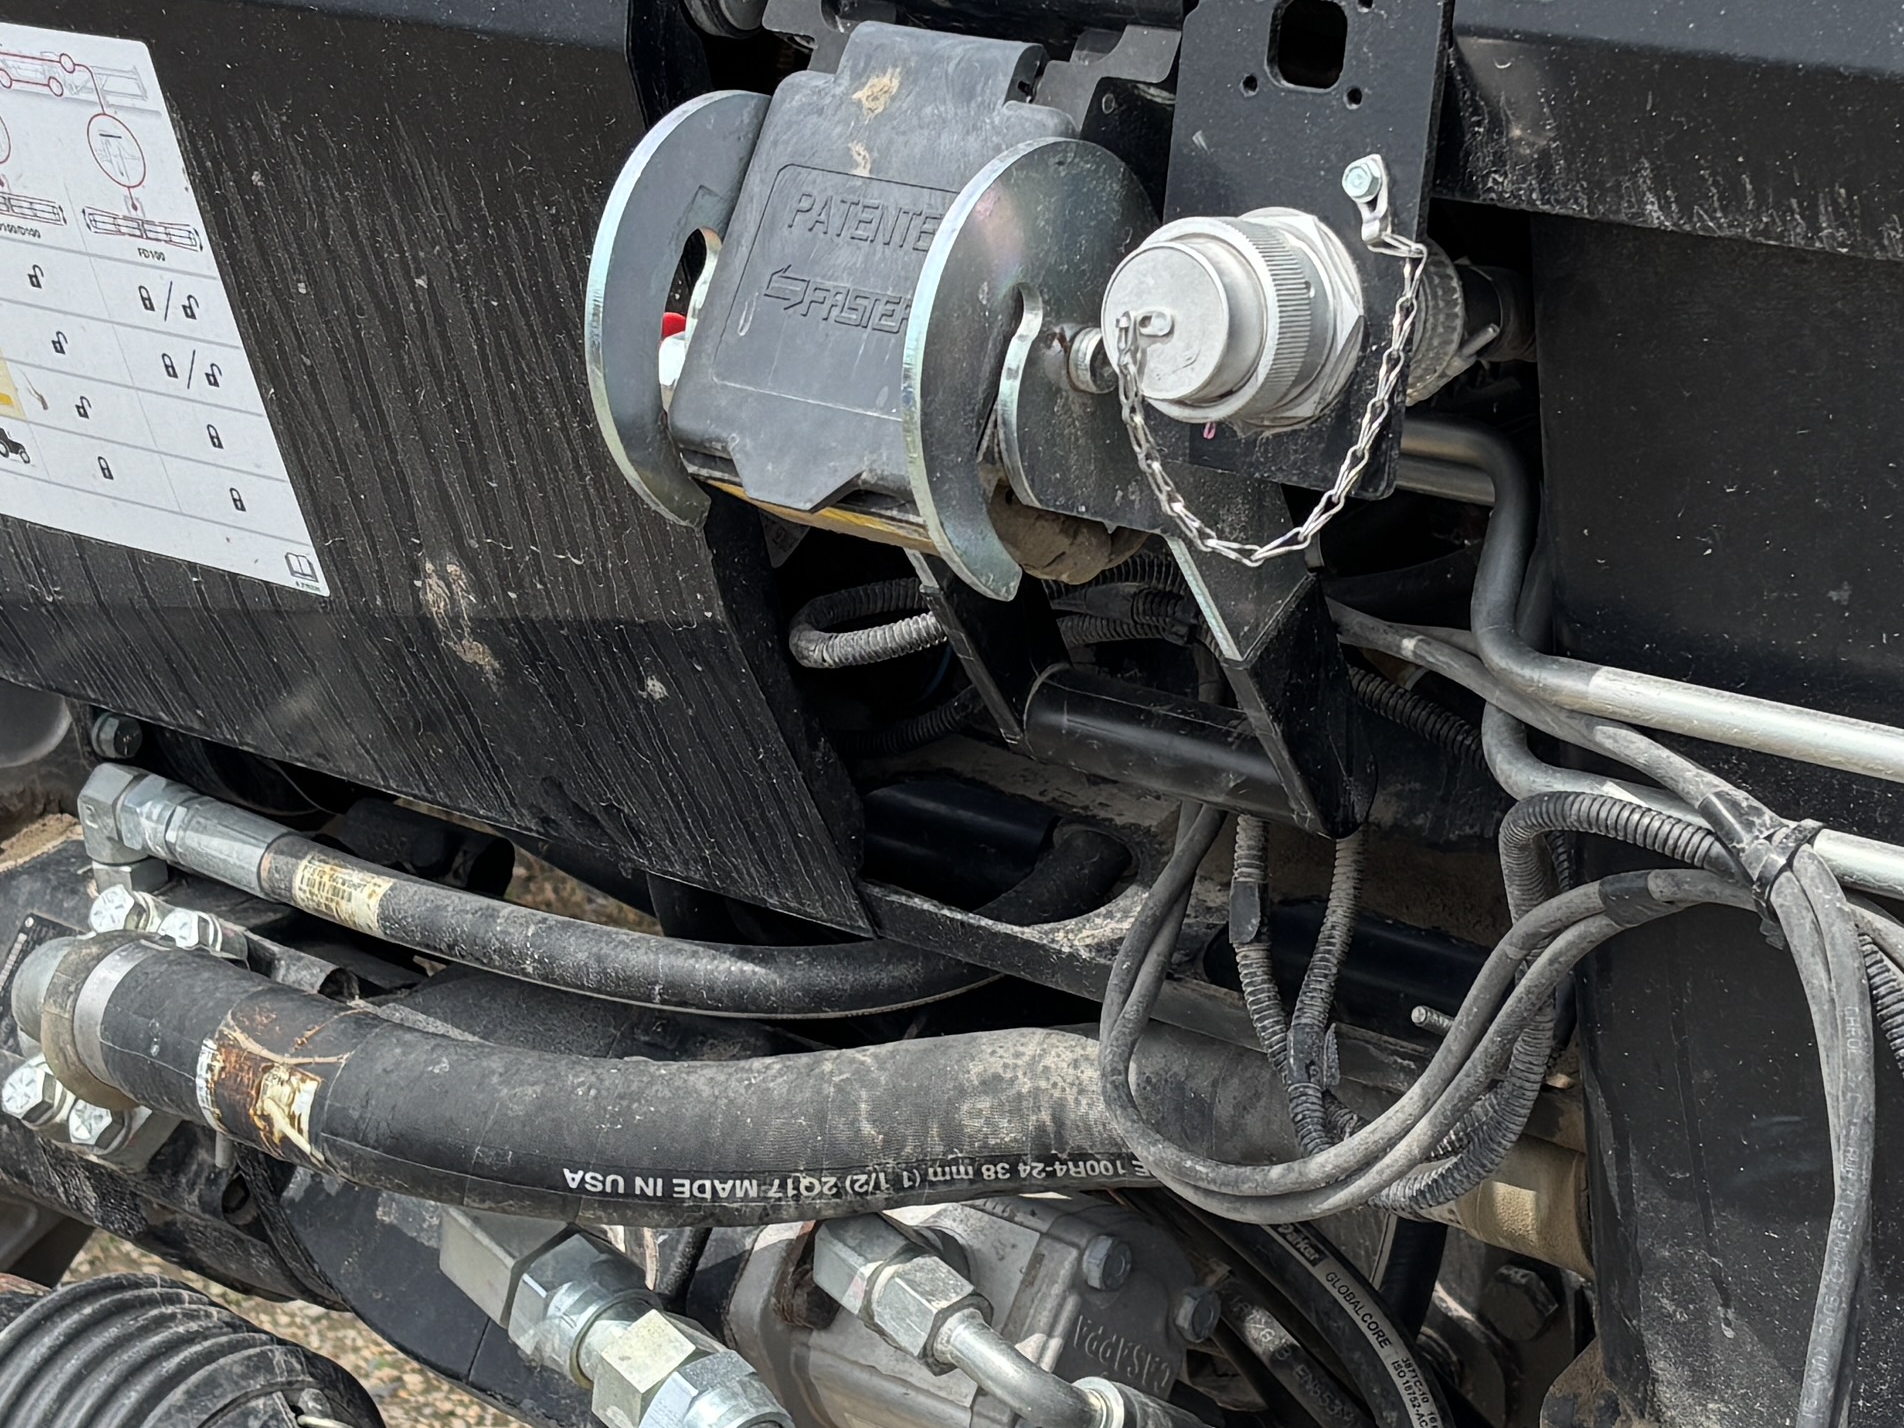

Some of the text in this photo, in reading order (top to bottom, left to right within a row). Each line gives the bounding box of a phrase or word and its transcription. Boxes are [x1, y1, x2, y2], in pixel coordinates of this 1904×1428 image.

[788, 192, 944, 252] PATENTE
[928, 1164, 974, 1182] mm
[981, 1163, 1010, 1179] 38
[1018, 1159, 1127, 1180] 100R4-24
[563, 1167, 625, 1194] USA
[634, 1176, 663, 1197] IN
[672, 1178, 758, 1199] MADE
[767, 1175, 837, 1198] 2Q17
[1324, 1271, 1393, 1350] GLOBALCORE
[1391, 1360, 1406, 1379] ISO
